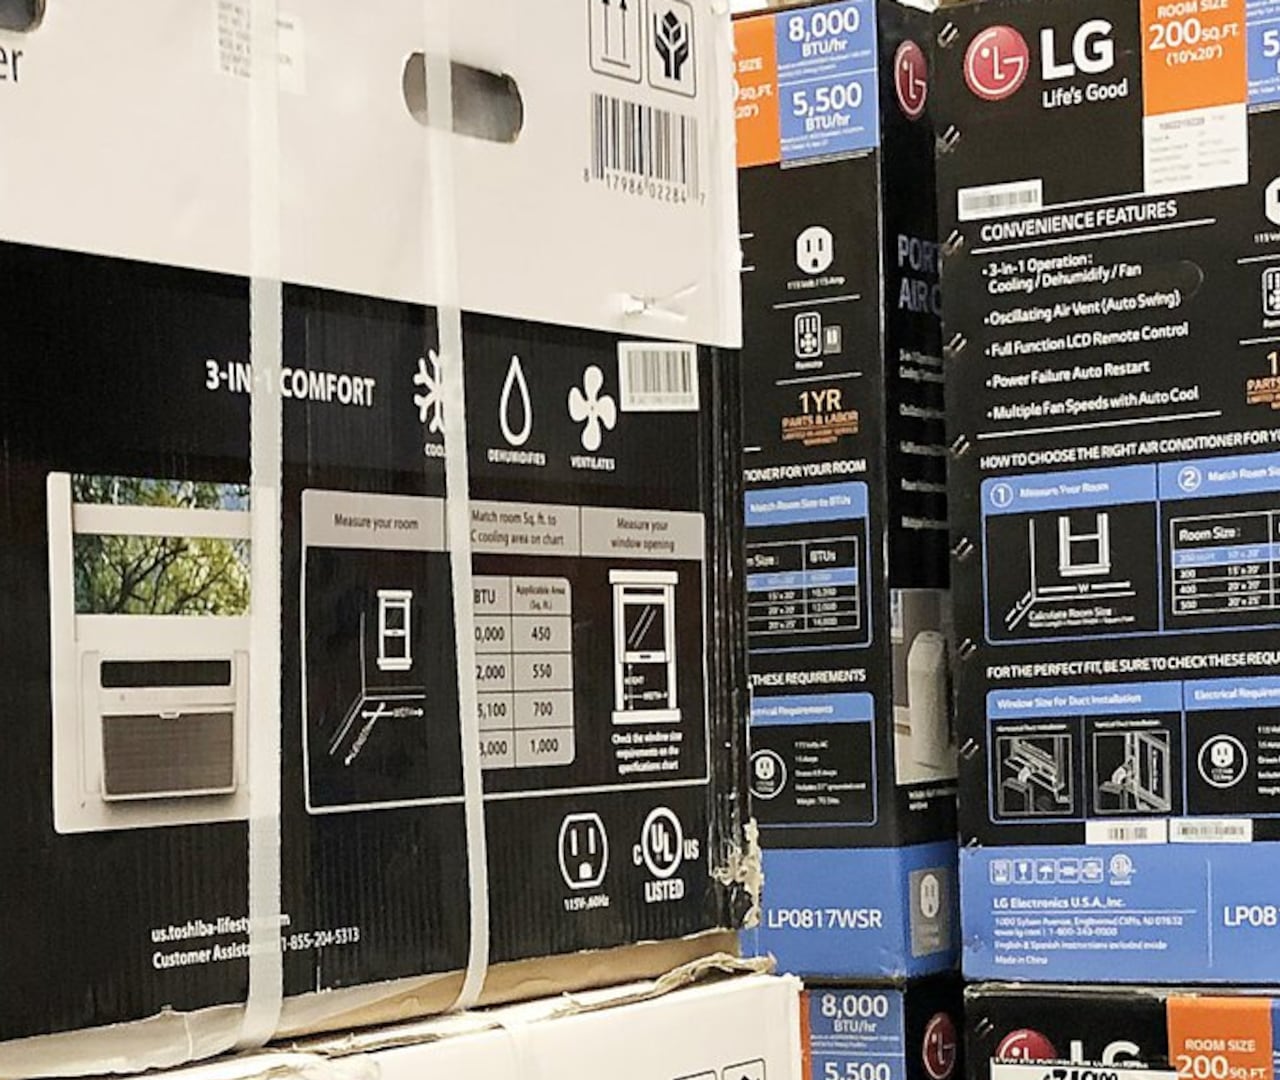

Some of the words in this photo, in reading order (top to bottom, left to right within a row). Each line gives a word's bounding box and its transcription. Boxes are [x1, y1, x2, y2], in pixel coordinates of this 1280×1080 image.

[788, 7, 860, 43] 8,000
[1149, 18, 1201, 49] 200
[802, 35, 847, 57] BTU/hr
[1039, 18, 1115, 80] LG
[792, 82, 862, 118] 5,500
[1043, 84, 1082, 109] Life's
[1085, 78, 1128, 105] Good
[806, 111, 851, 132] BTU/hr
[981, 212, 1094, 242] CONVENIENCE
[1096, 200, 1177, 226] FEATURES
[280, 367, 374, 407] COMFORT
[532, 627, 551, 641] 450
[533, 664, 552, 679] 550
[533, 702, 553, 717] 700
[530, 739, 558, 755] 1,000
[645, 881, 684, 904] LISTED
[768, 906, 882, 930] LP0817WSR
[821, 995, 888, 1020] 8,000
[833, 1018, 877, 1034] BTU/hr
[1176, 1055, 1228, 1079] 200
